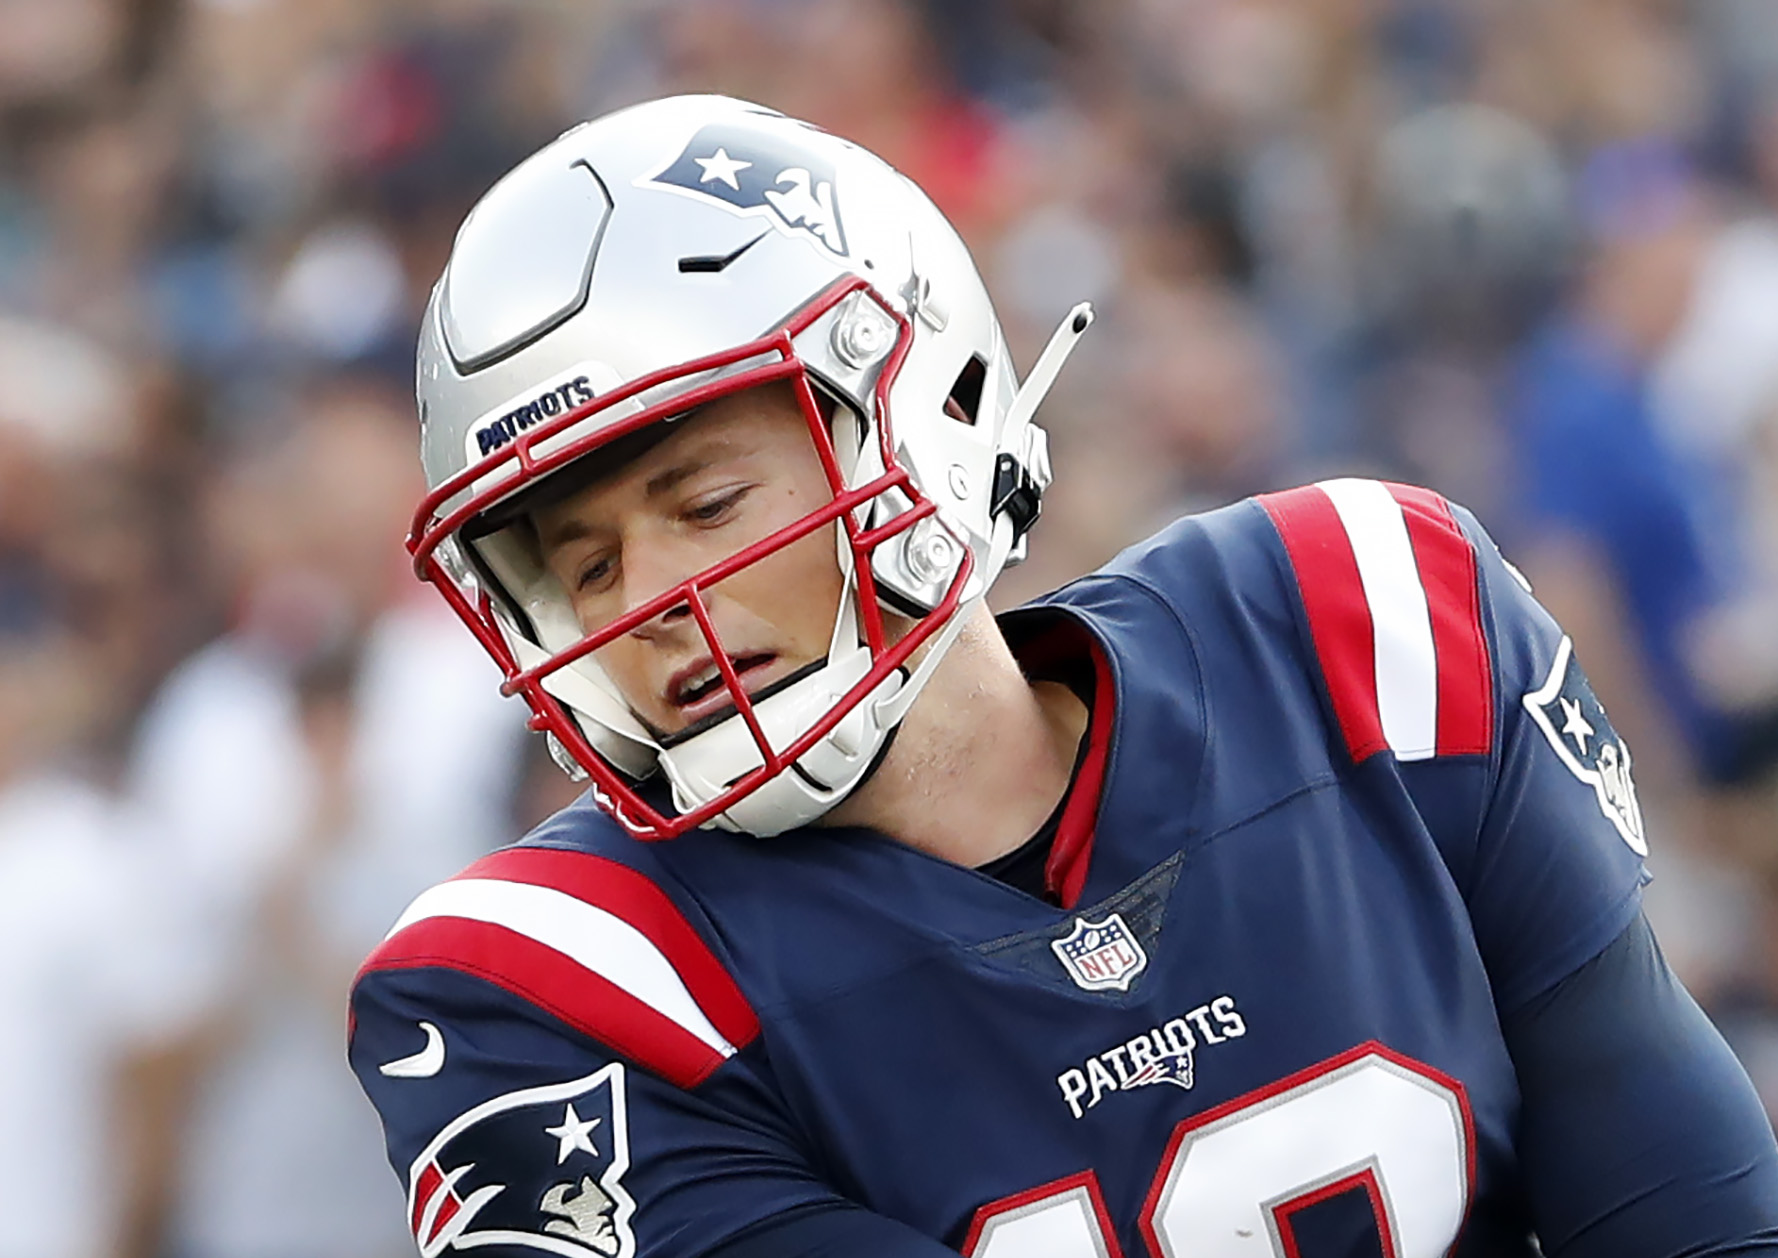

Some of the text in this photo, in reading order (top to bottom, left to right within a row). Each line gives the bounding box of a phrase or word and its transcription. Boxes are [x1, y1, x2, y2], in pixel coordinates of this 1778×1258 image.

[476, 376, 595, 457] PATRIOTS
[1078, 944, 1134, 979] NFL
[1057, 995, 1247, 1119] PATRIOTS
